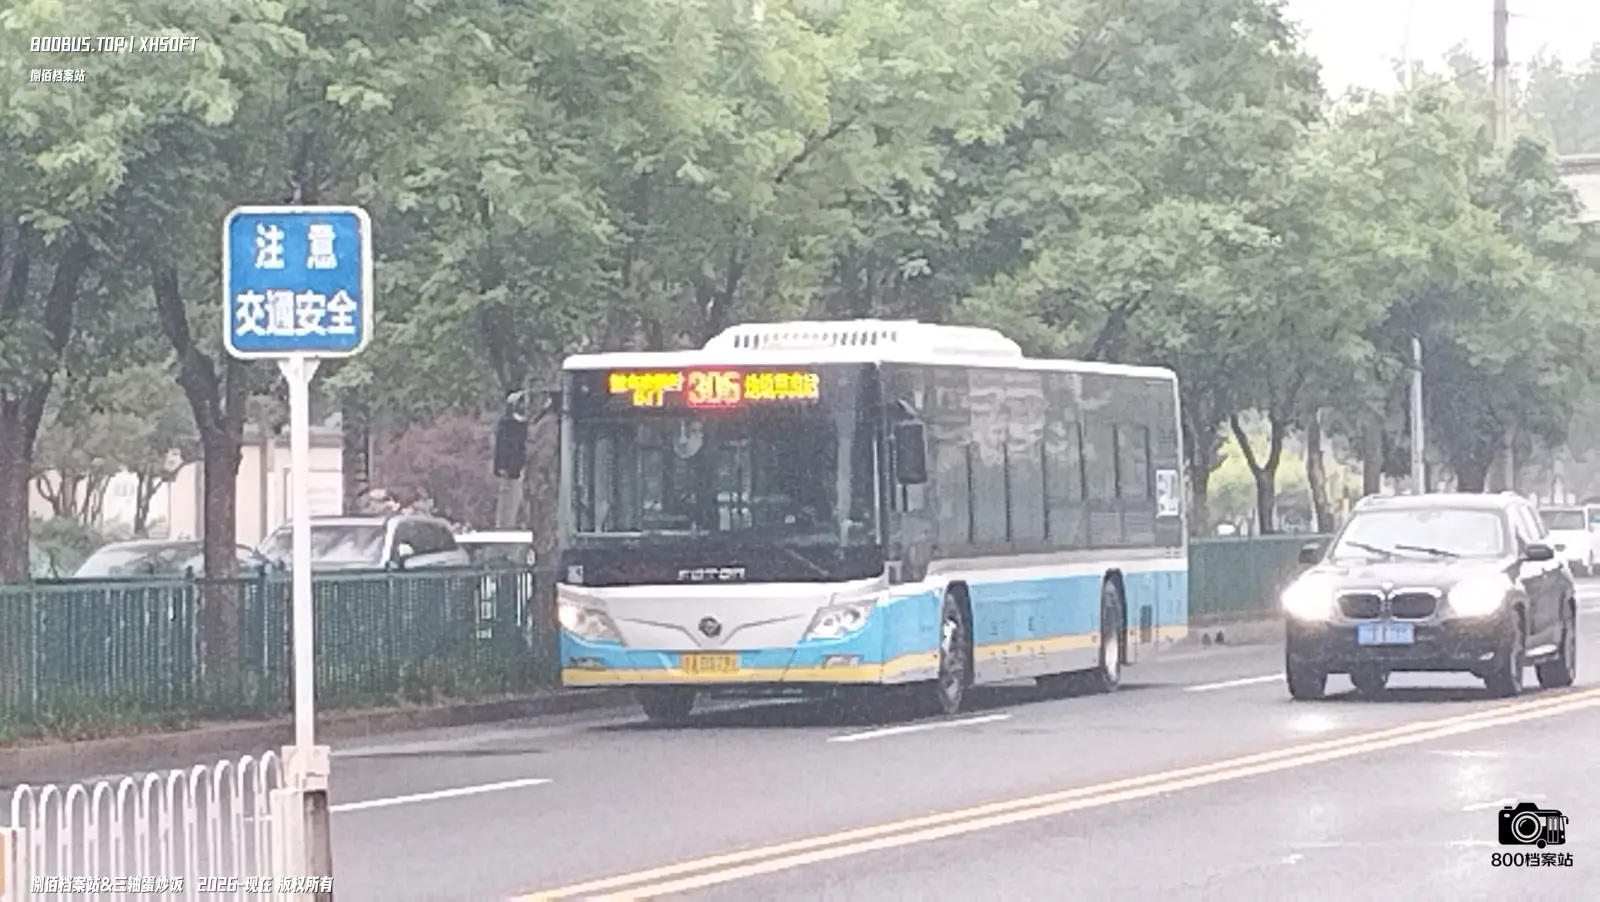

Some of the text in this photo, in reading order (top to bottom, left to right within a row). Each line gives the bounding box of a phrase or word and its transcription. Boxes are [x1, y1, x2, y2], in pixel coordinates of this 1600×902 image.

[255, 223, 338, 270] 注意
[235, 289, 358, 336] 交通安全
[688, 370, 741, 407] 306
